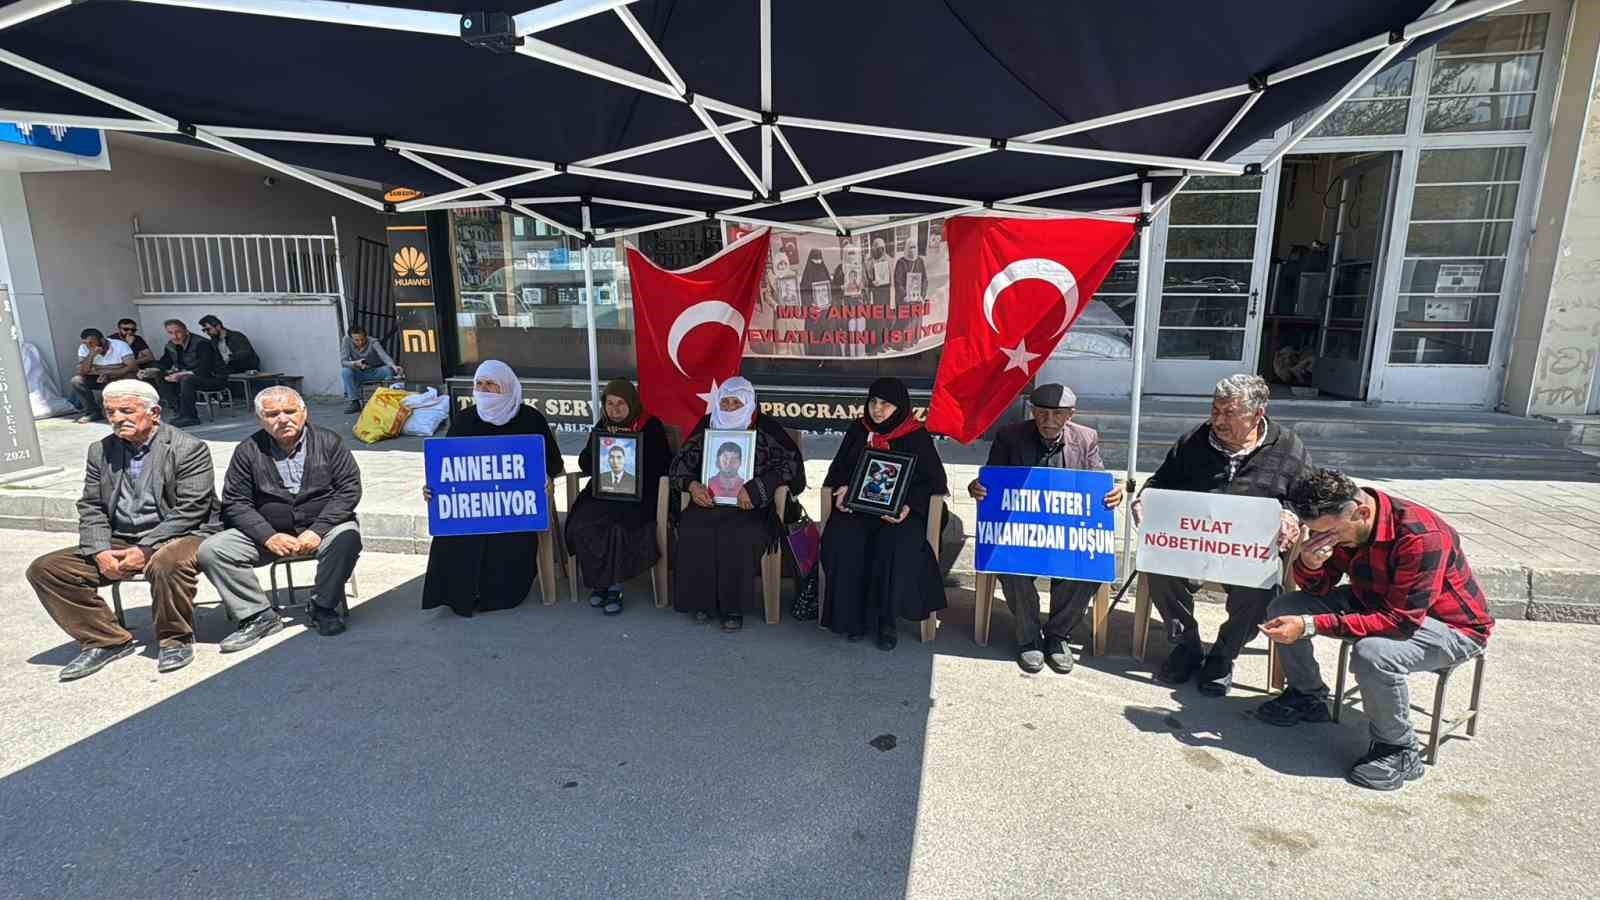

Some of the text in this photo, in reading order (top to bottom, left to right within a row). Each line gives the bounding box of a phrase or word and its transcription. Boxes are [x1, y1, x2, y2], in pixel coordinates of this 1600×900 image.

[394, 278, 431, 287] HUAWEI
[777, 300, 931, 320] MUŞ ANNELERİ
[882, 322, 943, 346] İSTİYO
[759, 401, 865, 419] PROGRAM
[5, 449, 31, 461] 2021
[440, 454, 525, 483] ANNELER
[438, 485, 537, 519] DİRENİYOR
[1001, 488, 1041, 513] ARTIK
[1043, 490, 1083, 516] YETER
[1180, 518, 1232, 534] EVLAT
[978, 521, 1114, 560] YAKAMIZDAN DÜŞÜN
[1144, 533, 1271, 560] NÖBETİNDEYİZ
